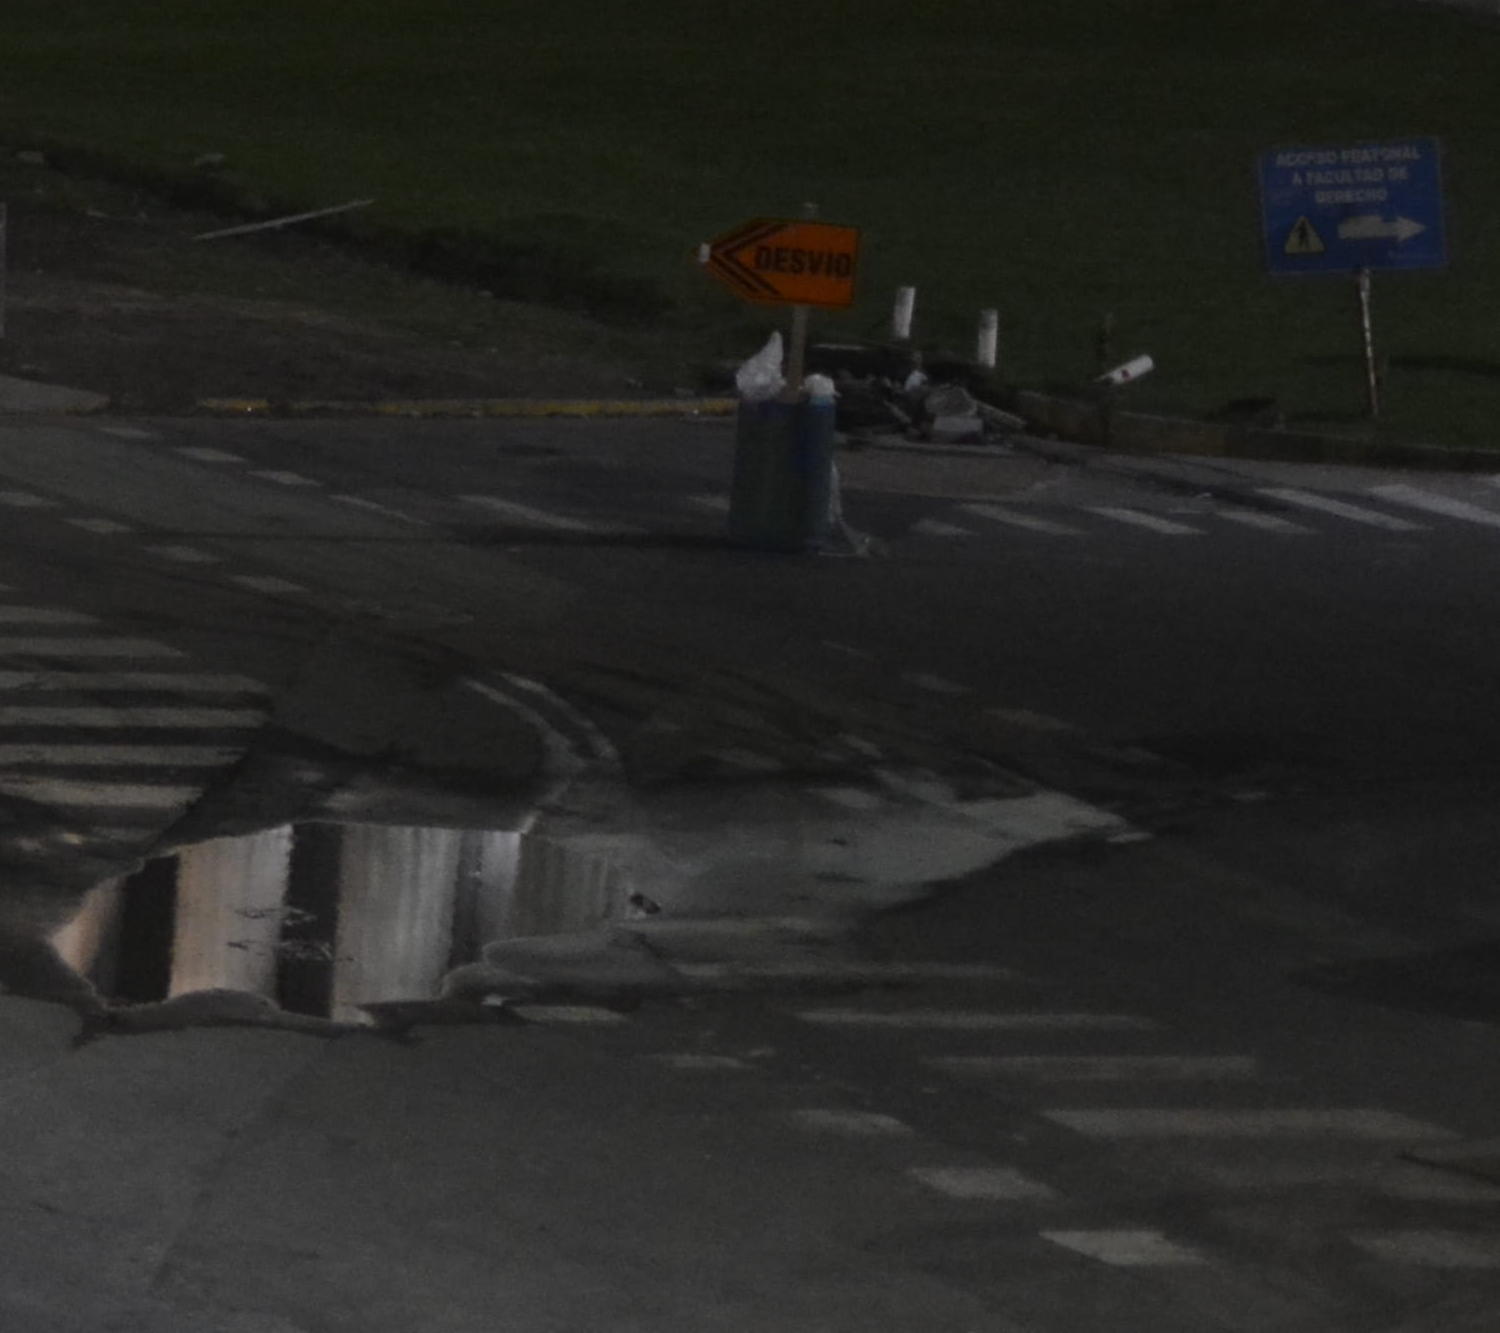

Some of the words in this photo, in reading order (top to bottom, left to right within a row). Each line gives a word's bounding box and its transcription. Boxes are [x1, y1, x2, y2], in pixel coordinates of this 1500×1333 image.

[1292, 172, 1304, 186] A
[1306, 166, 1385, 186] FACULTAD
[1387, 166, 1410, 181] DE
[1315, 188, 1389, 205] DERECHO
[756, 245, 851, 277] DESVIO
